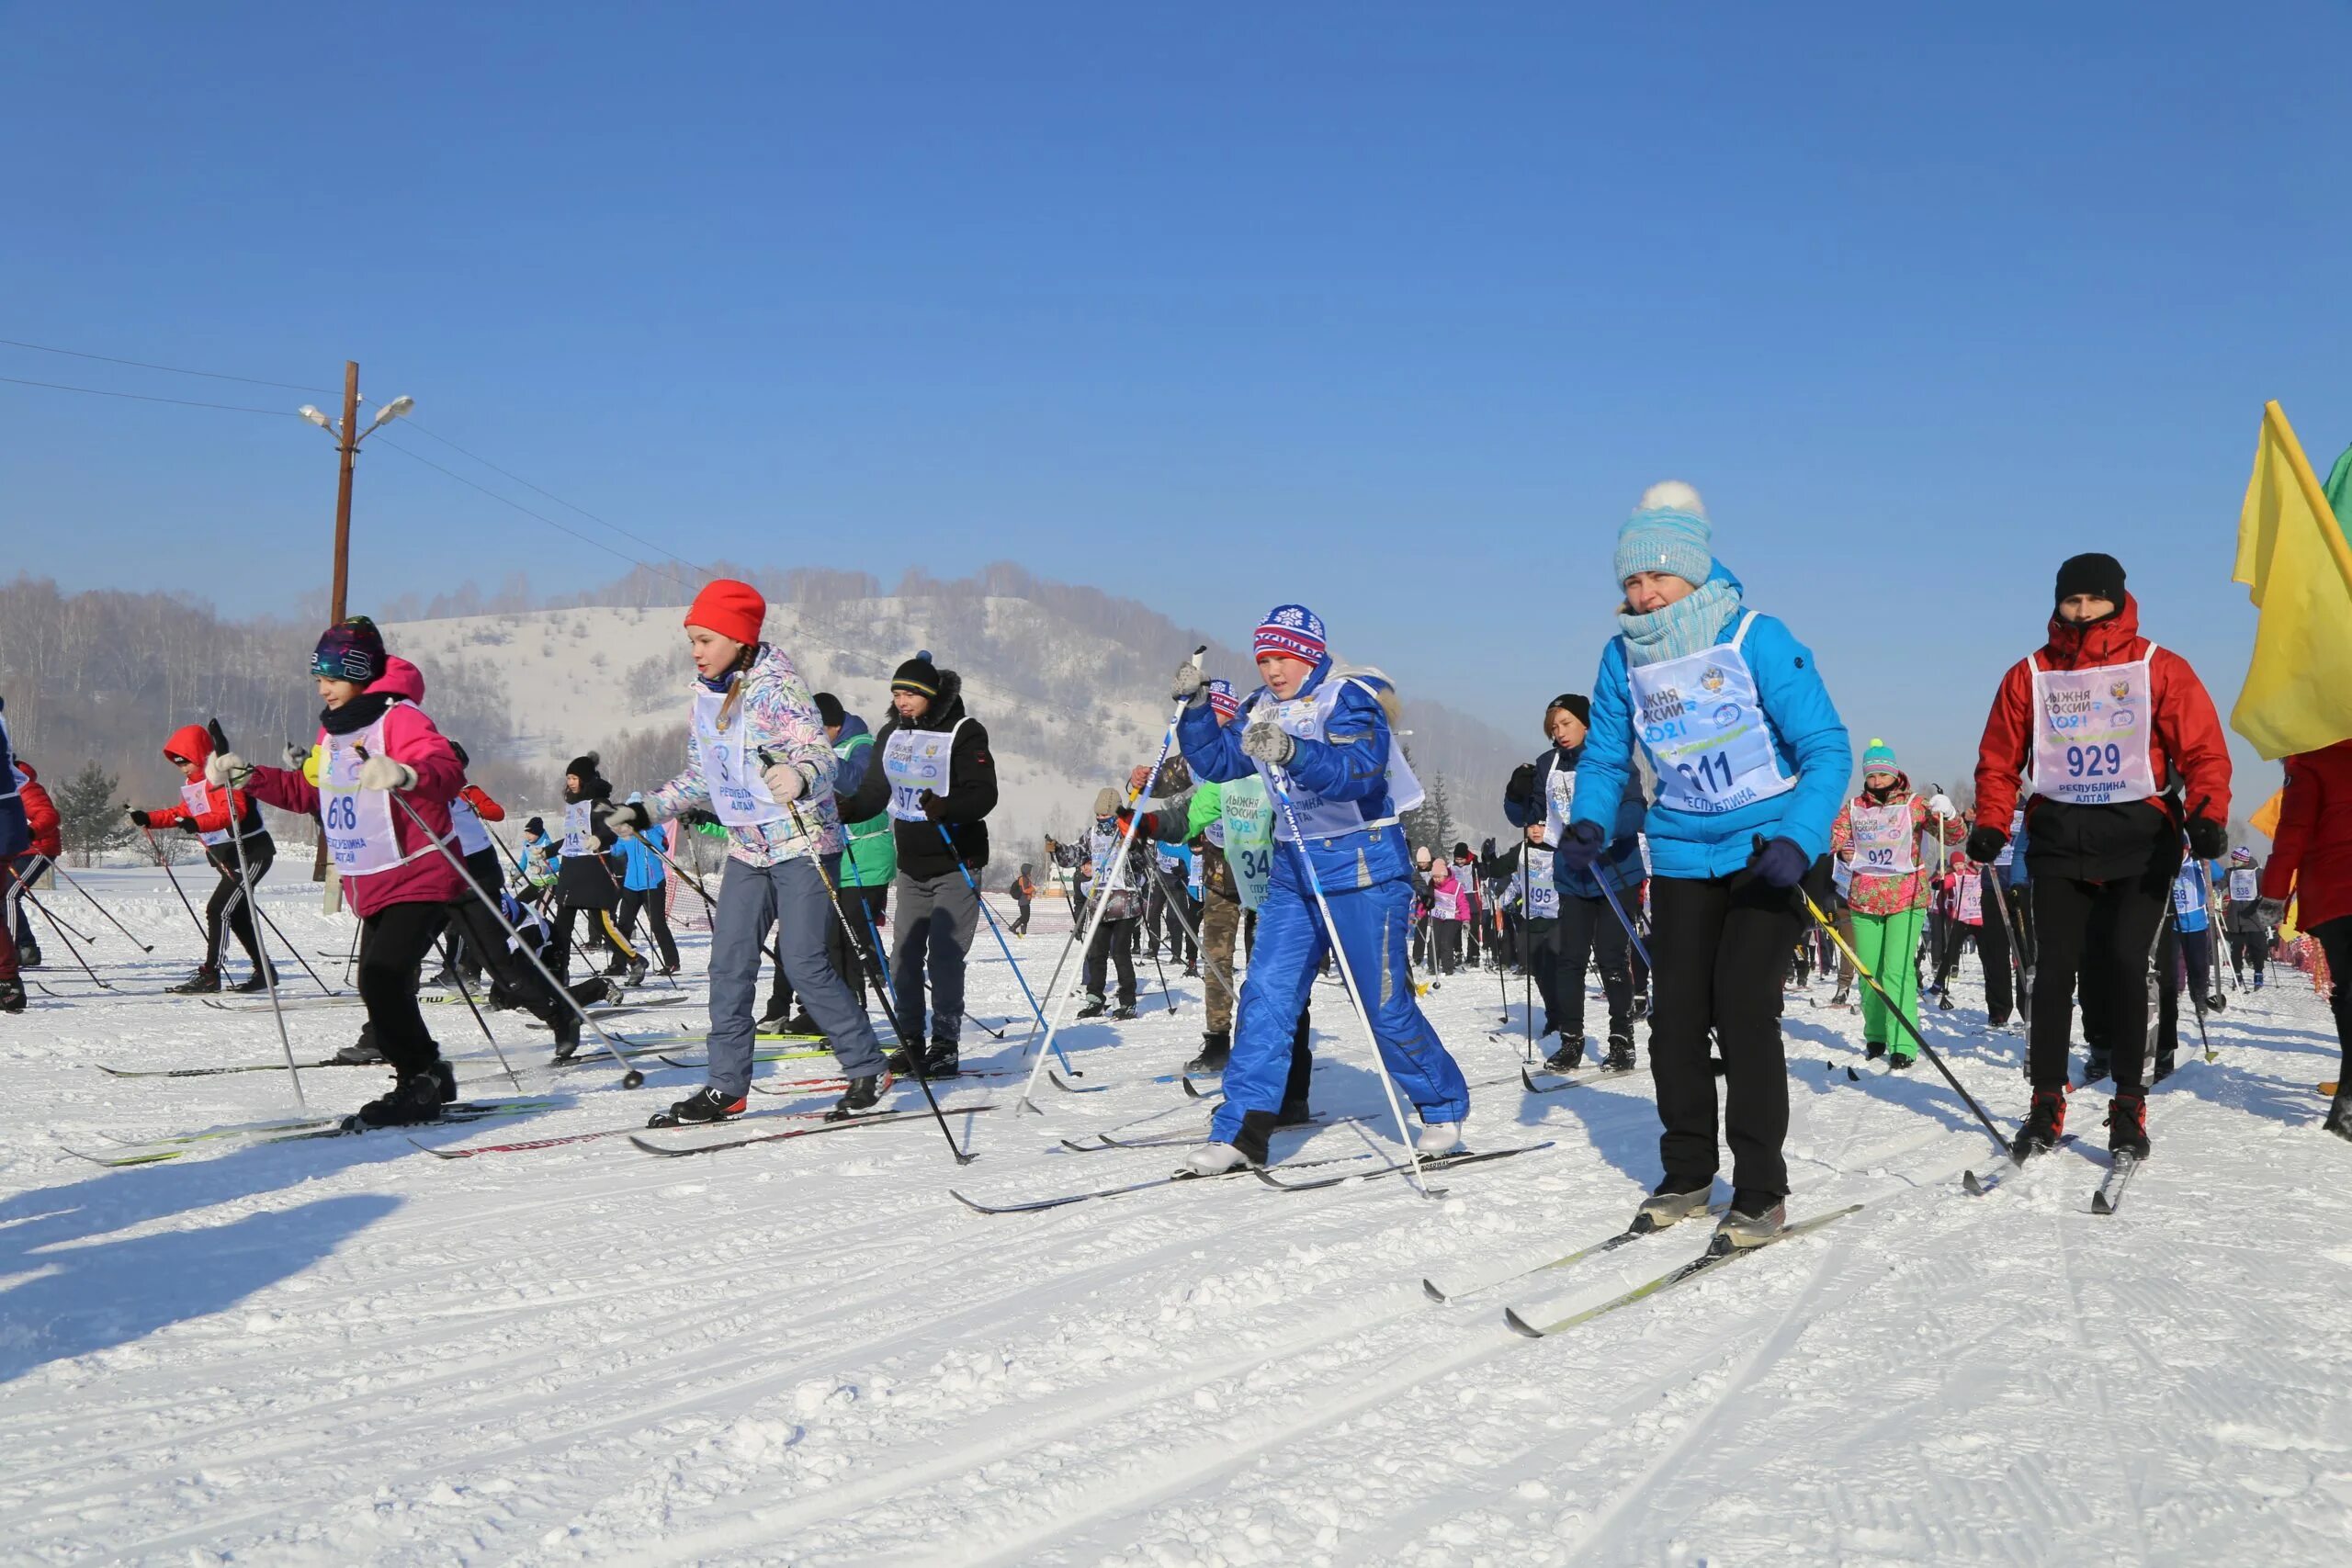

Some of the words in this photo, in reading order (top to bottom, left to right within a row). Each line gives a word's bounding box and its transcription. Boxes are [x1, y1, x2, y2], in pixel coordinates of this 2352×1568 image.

[1147, 744, 1168, 788] NORDWAY
[2067, 743, 2120, 778] 929
[2059, 780, 2127, 793] РЕСПУБЛИКА
[2075, 793, 2110, 804] АЛТАЙ
[1226, 807, 1259, 819] РОССИИ
[1283, 804, 1306, 852] NORDWAY
[1869, 848, 1893, 865] 912
[1530, 886, 1552, 903] 495
[1434, 908, 1447, 919] 626
[1420, 1159, 1450, 1172] NORDWAY
